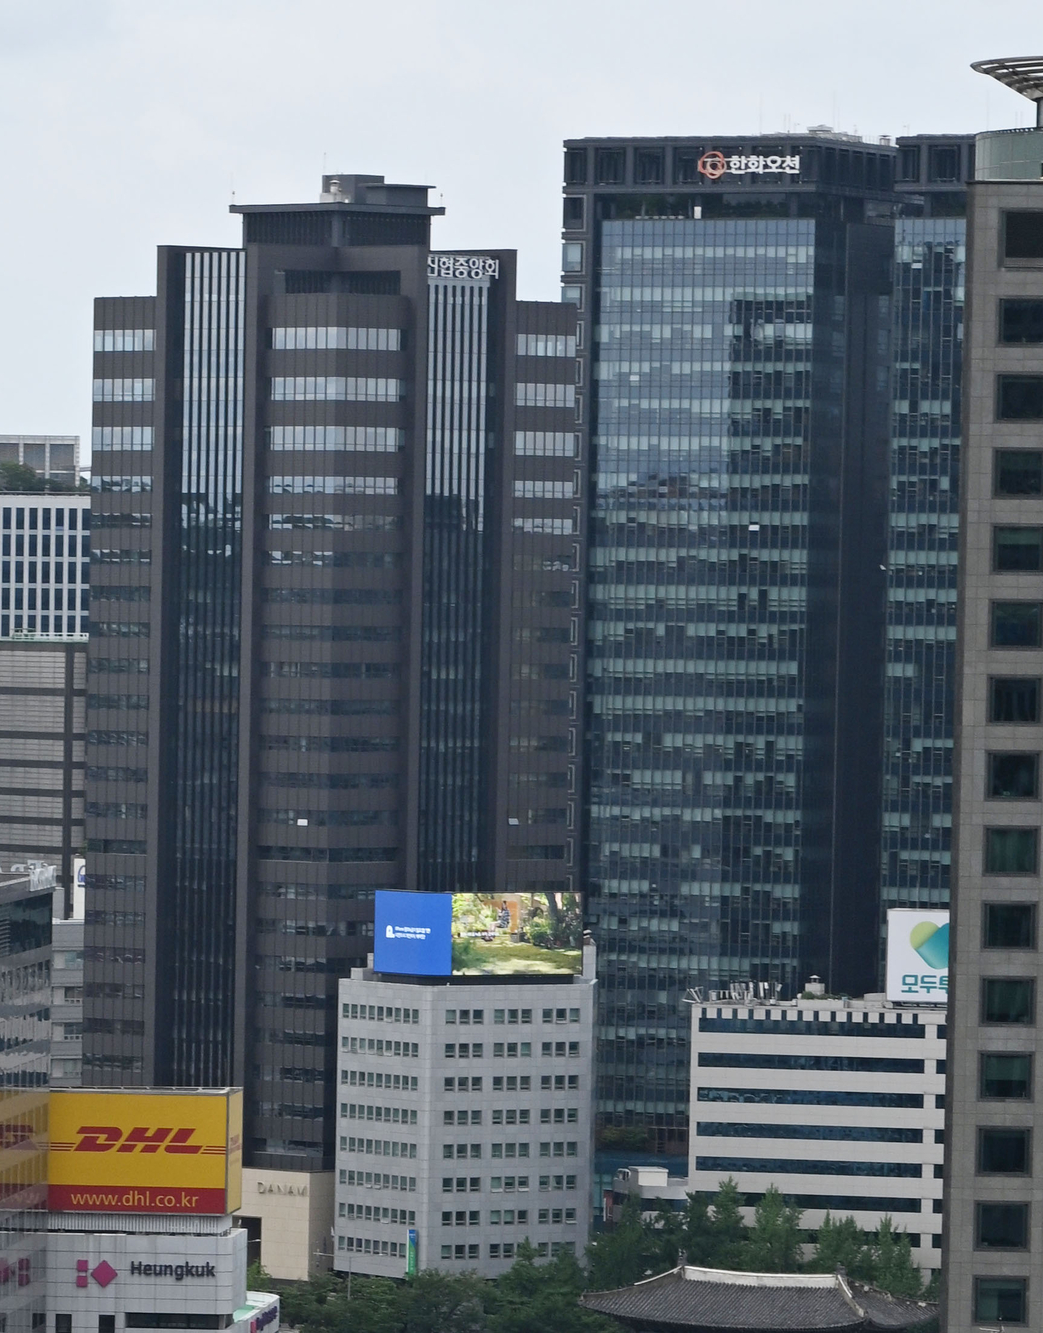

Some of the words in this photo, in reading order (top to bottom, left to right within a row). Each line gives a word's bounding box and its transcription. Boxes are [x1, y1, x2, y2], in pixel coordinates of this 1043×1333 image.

[729, 155, 801, 174] 한화오션
[74, 1126, 204, 1154] DHL
[71, 1190, 199, 1209] www.dhl.co.kr
[130, 1261, 216, 1281] Heungkuk
